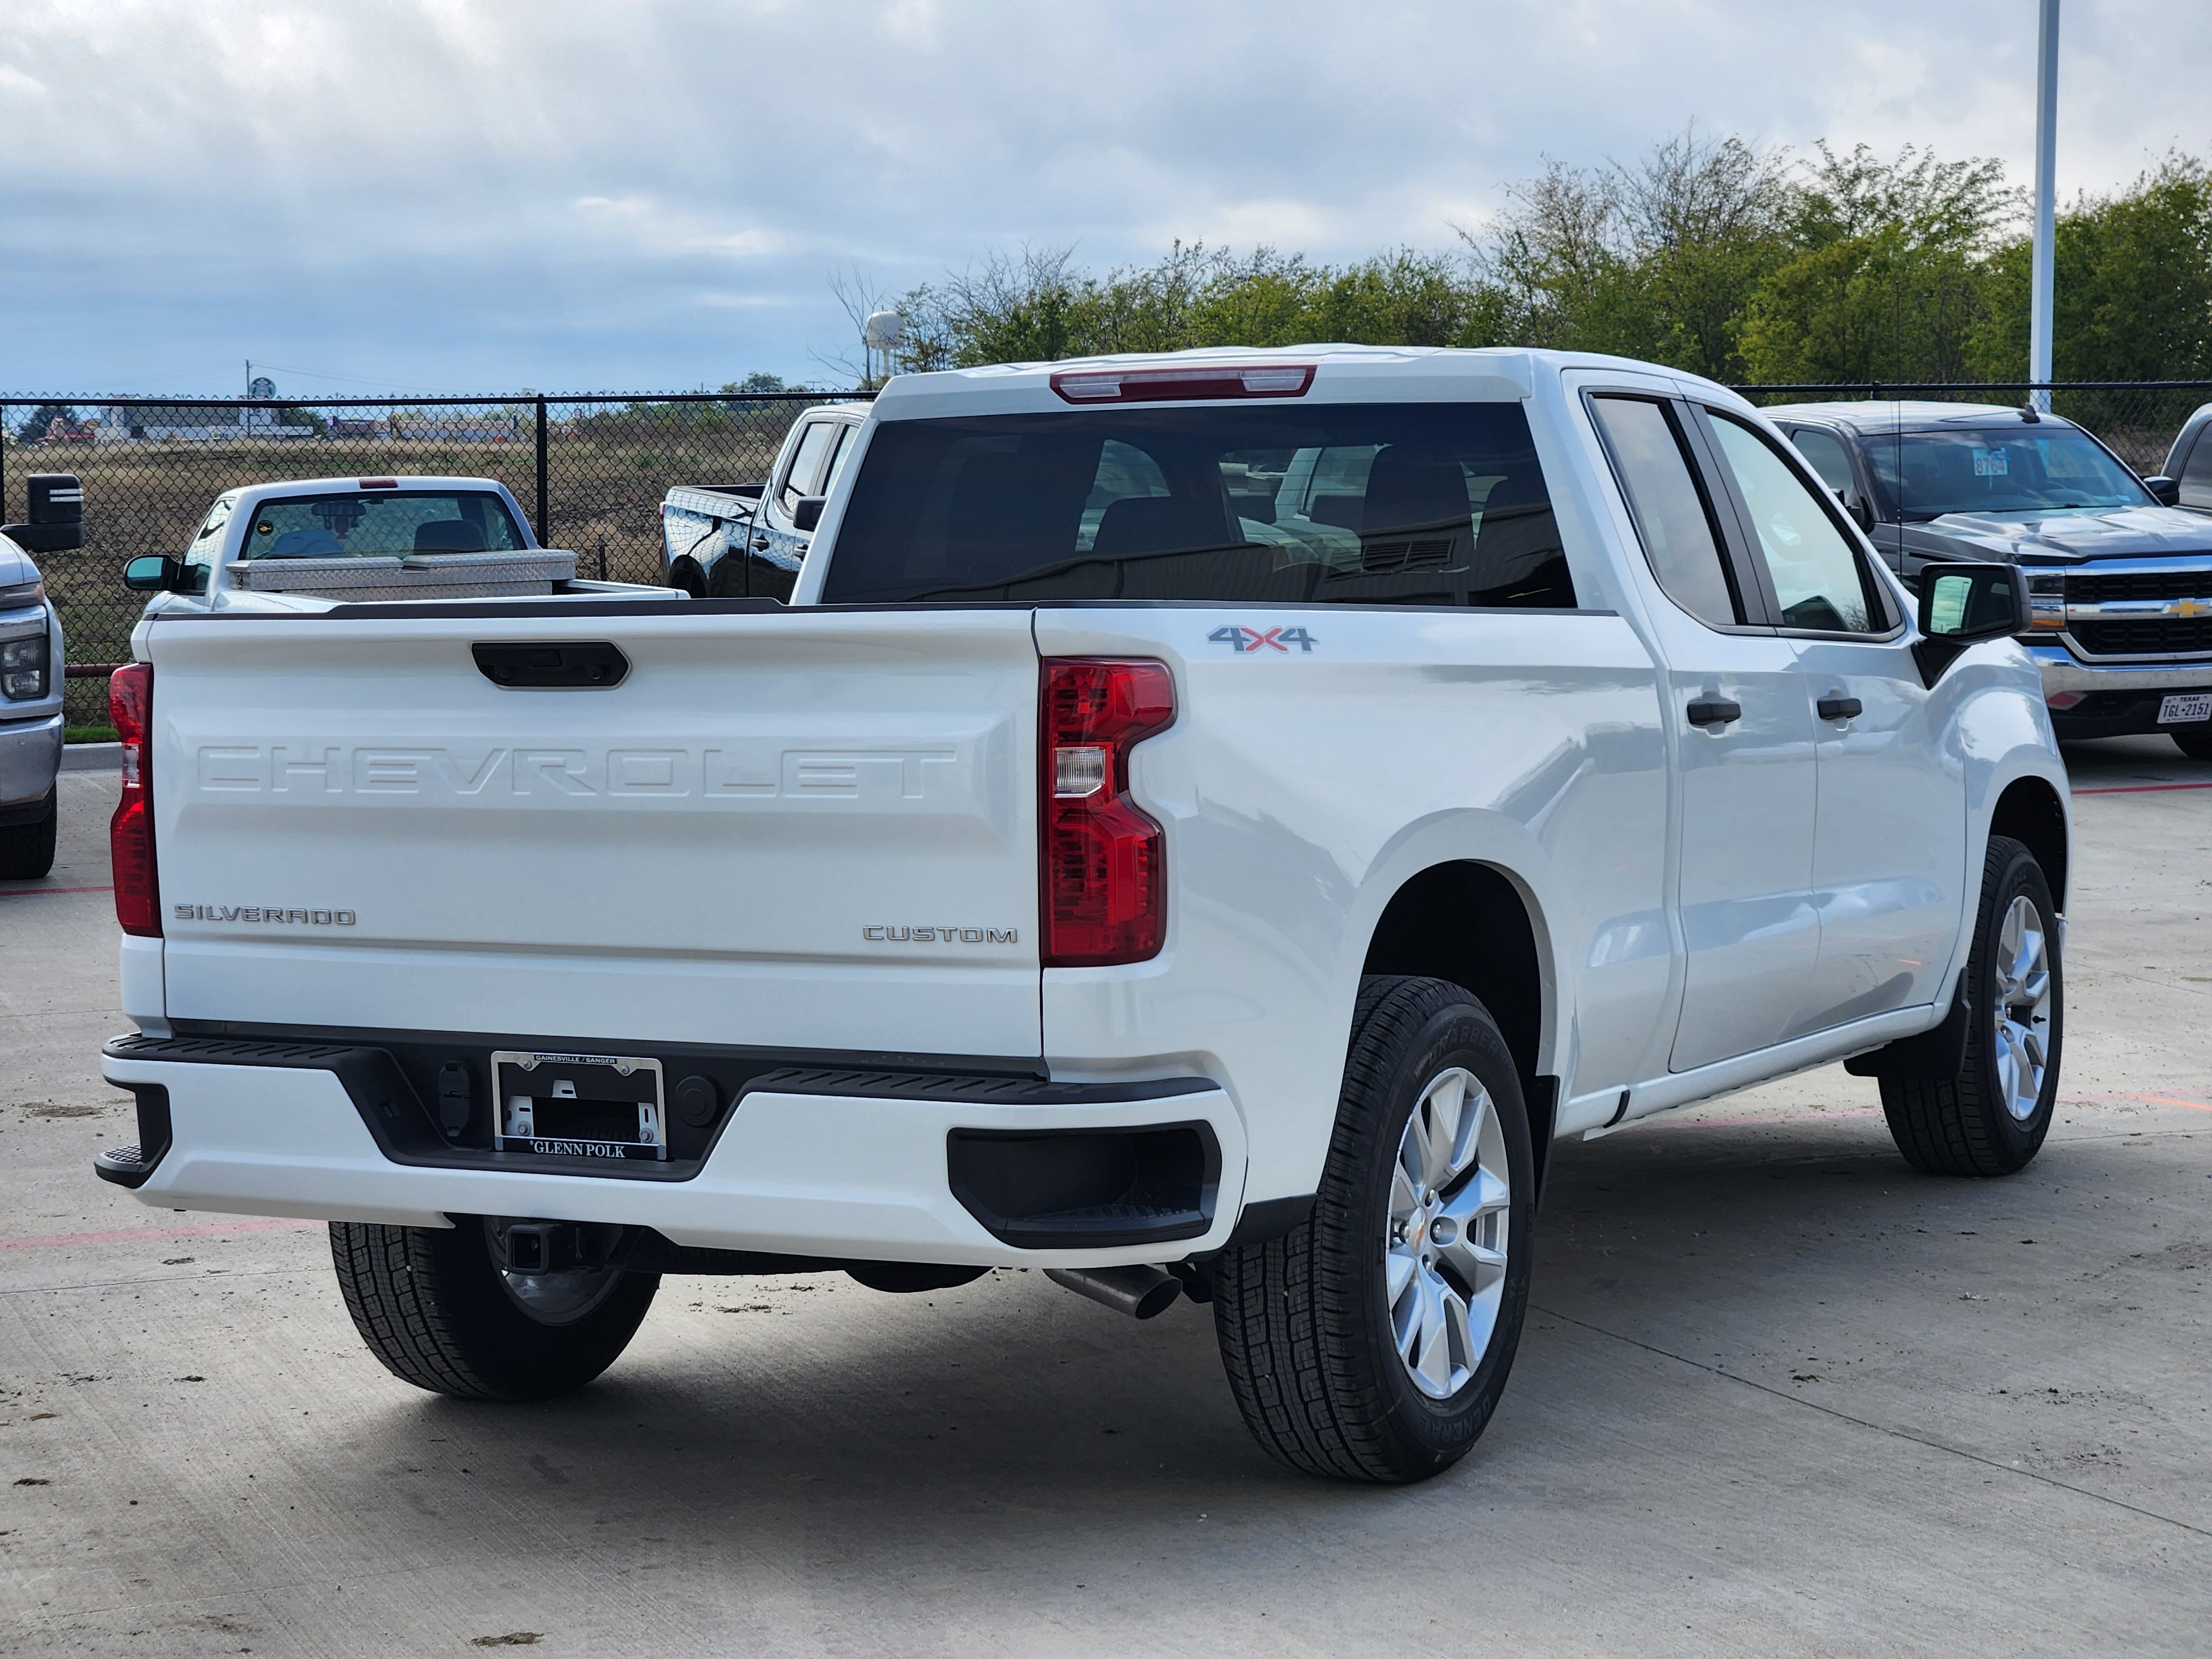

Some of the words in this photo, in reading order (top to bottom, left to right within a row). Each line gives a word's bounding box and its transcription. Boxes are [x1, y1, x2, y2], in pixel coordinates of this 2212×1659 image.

[198, 745, 957, 799] CHEVROLET
[174, 903, 356, 925] SILVERADO
[863, 926, 1018, 943] CUSTOM
[534, 1141, 583, 1155] GLENN
[585, 1144, 625, 1158] POLK
